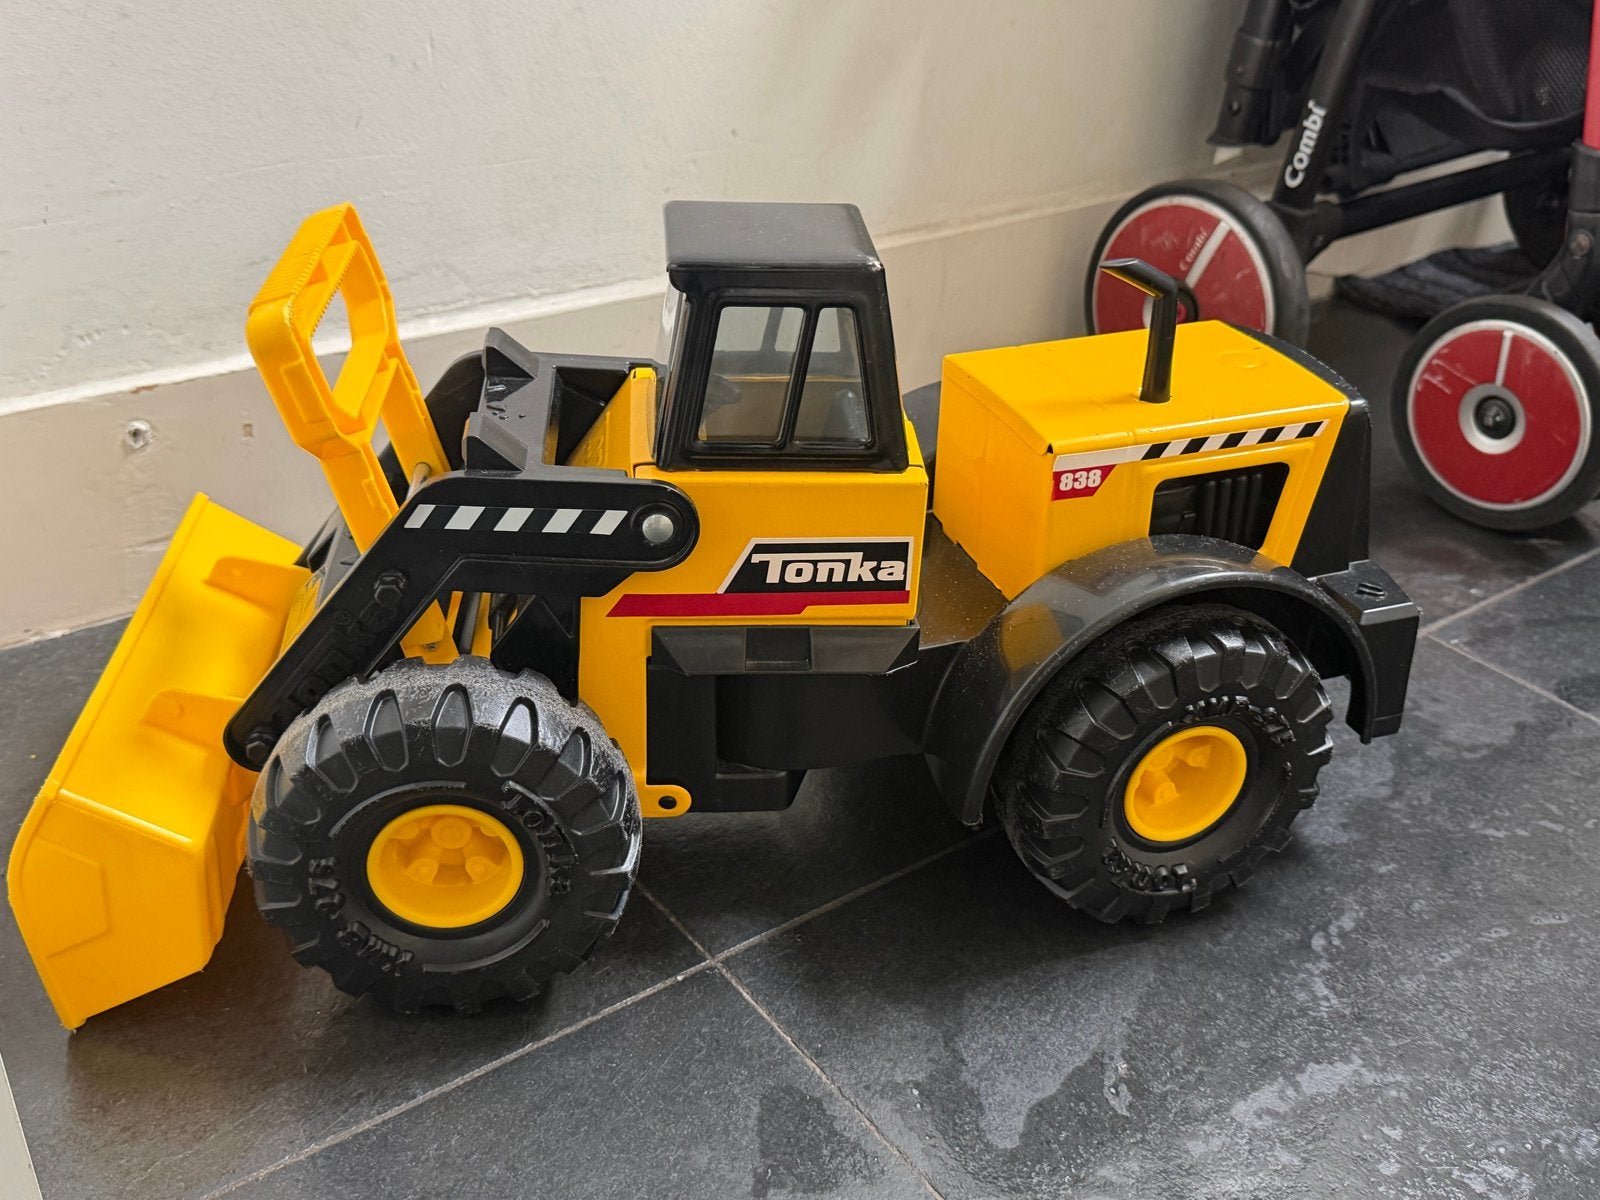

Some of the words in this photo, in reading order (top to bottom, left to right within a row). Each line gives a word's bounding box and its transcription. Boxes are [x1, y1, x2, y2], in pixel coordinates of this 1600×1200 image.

[1284, 99, 1328, 189] Combi
[1059, 468, 1102, 491] 838
[751, 551, 905, 584] Tonka
